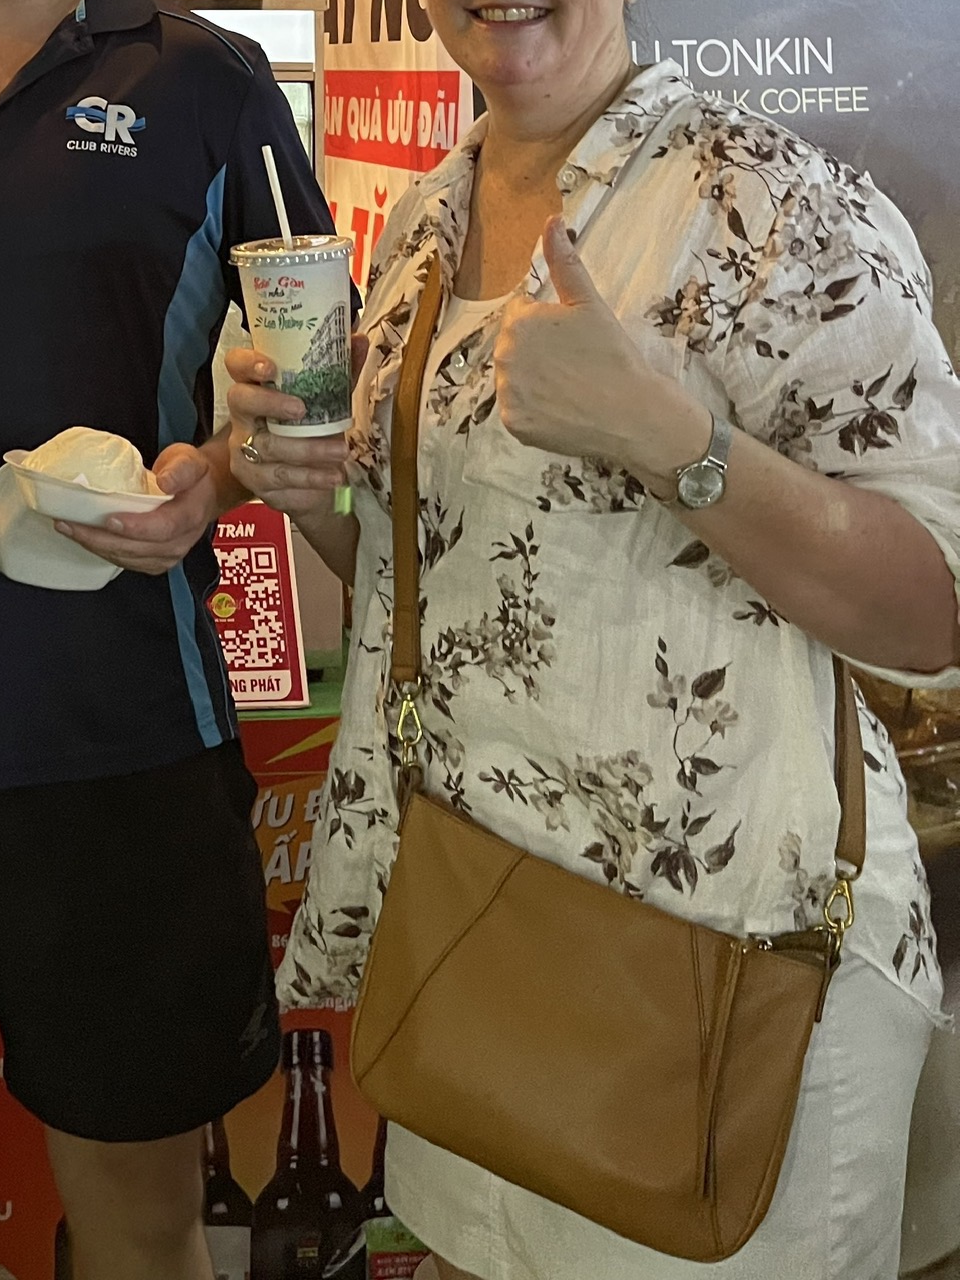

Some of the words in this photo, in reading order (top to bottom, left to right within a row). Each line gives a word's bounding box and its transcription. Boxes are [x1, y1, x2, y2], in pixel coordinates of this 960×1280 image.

[672, 37, 834, 77] TONKIN
[760, 86, 870, 115] COFFEE
[347, 84, 383, 144] QUÀ
[417, 89, 456, 150] ĐÃI
[66, 140, 97, 152] CLUB
[100, 142, 138, 158] RIVERS
[217, 521, 256, 538] TRÀN
[250, 676, 281, 693] PHÁT
